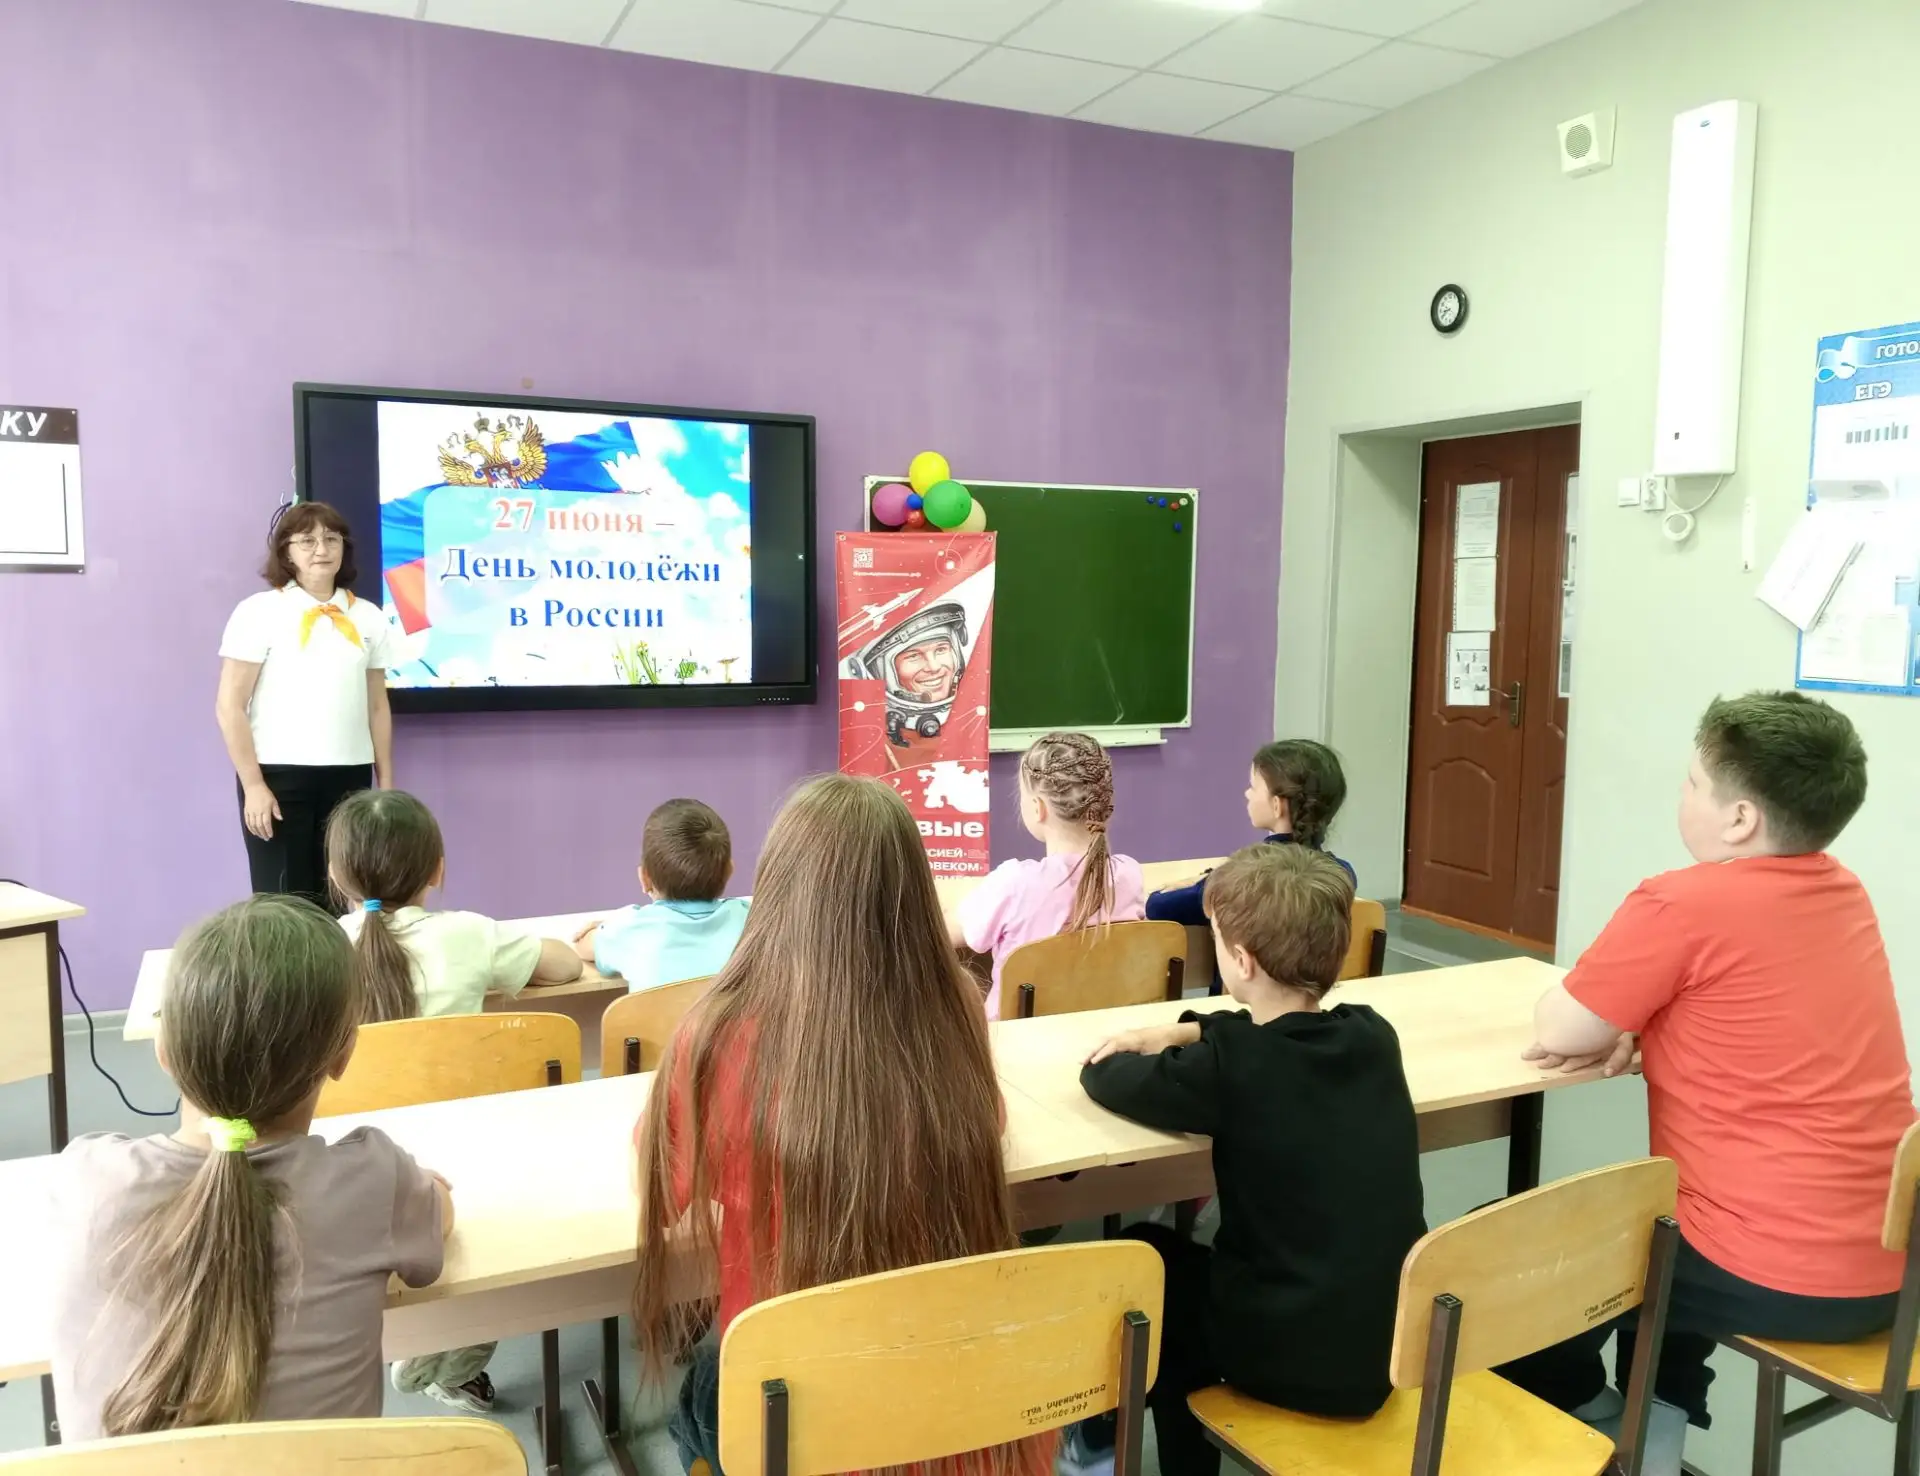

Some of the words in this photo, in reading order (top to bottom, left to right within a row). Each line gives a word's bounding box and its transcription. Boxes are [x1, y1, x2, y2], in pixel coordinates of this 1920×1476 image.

[1875, 339, 1920, 360] ГОТО
[1855, 381, 1892, 401] ЕГЭ
[494, 498, 535, 530] 27
[547, 509, 644, 533] июня
[440, 547, 537, 581] День
[550, 554, 721, 583] молодёжи
[510, 607, 529, 627] в
[544, 599, 664, 628] России
